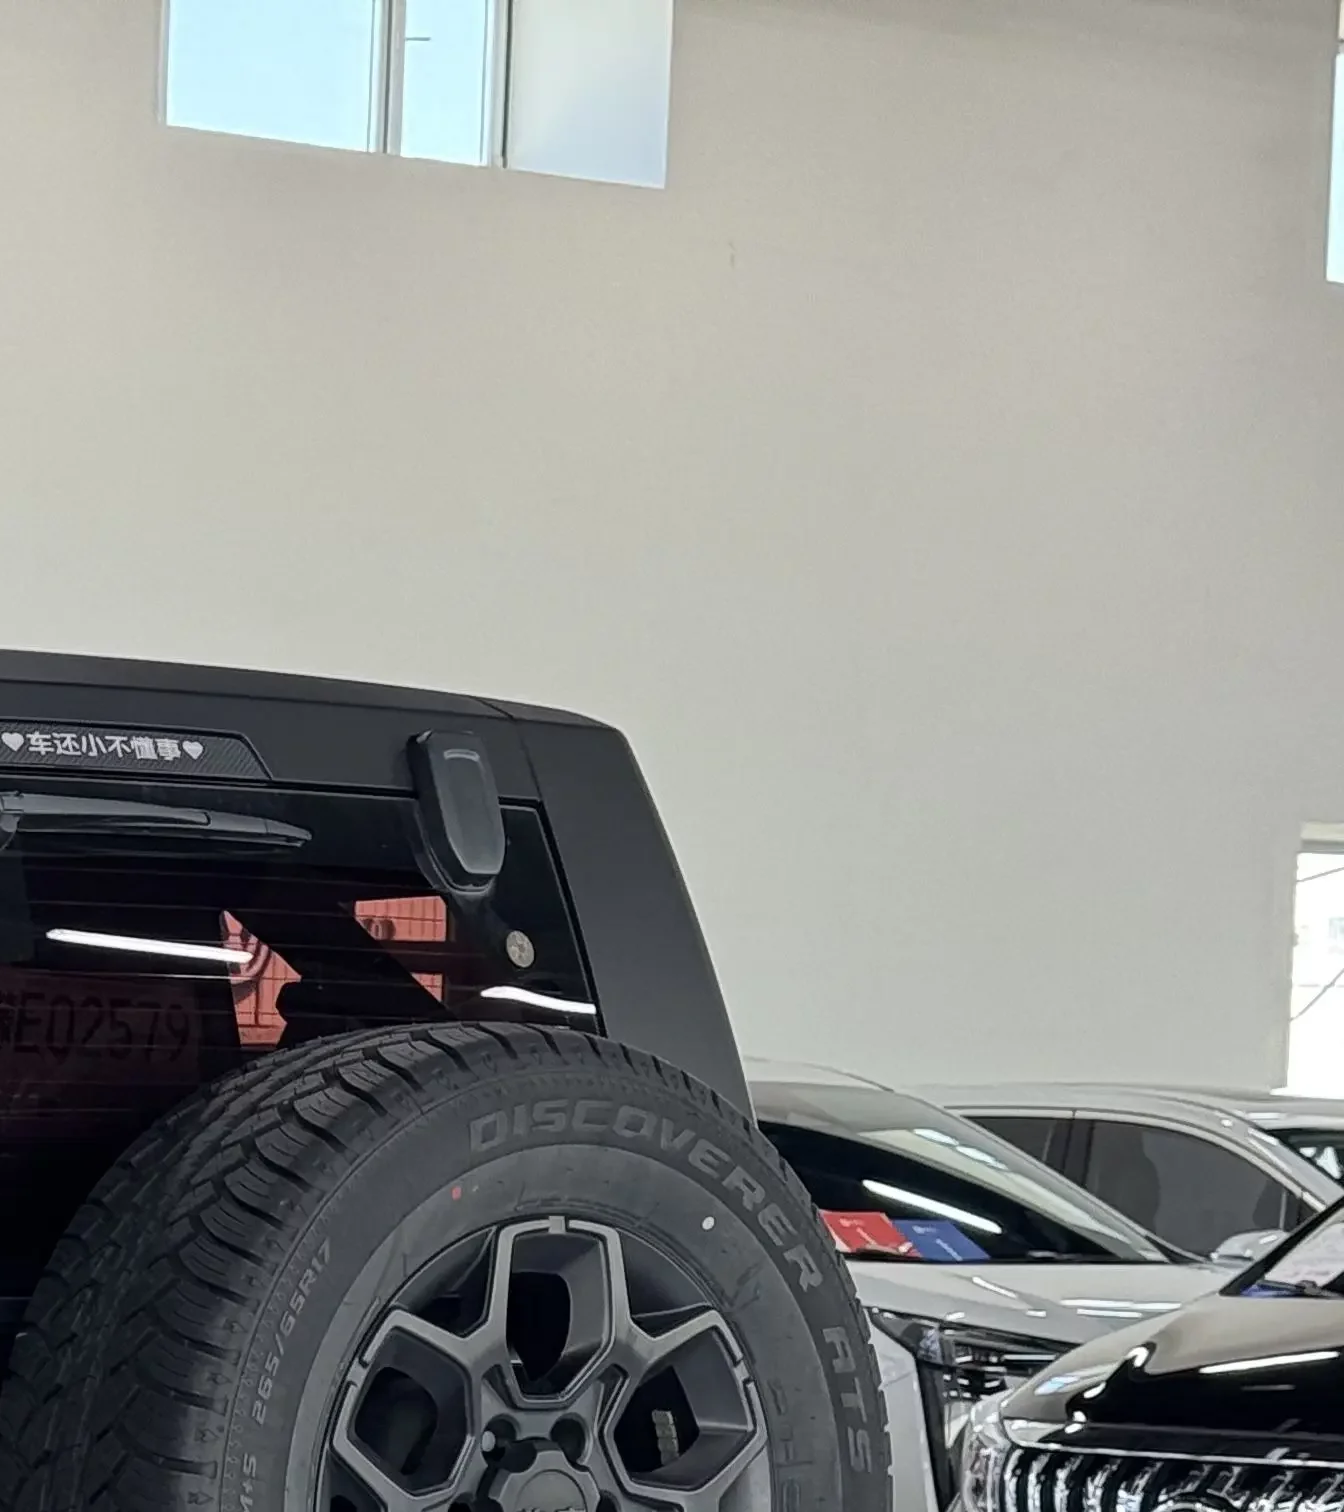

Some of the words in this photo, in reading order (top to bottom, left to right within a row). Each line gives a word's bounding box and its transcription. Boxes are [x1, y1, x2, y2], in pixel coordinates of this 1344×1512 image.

[252, 1238, 335, 1431] 265/65R17
[466, 1097, 820, 1293] DISCOVERER
[820, 1324, 873, 1476] ATS
